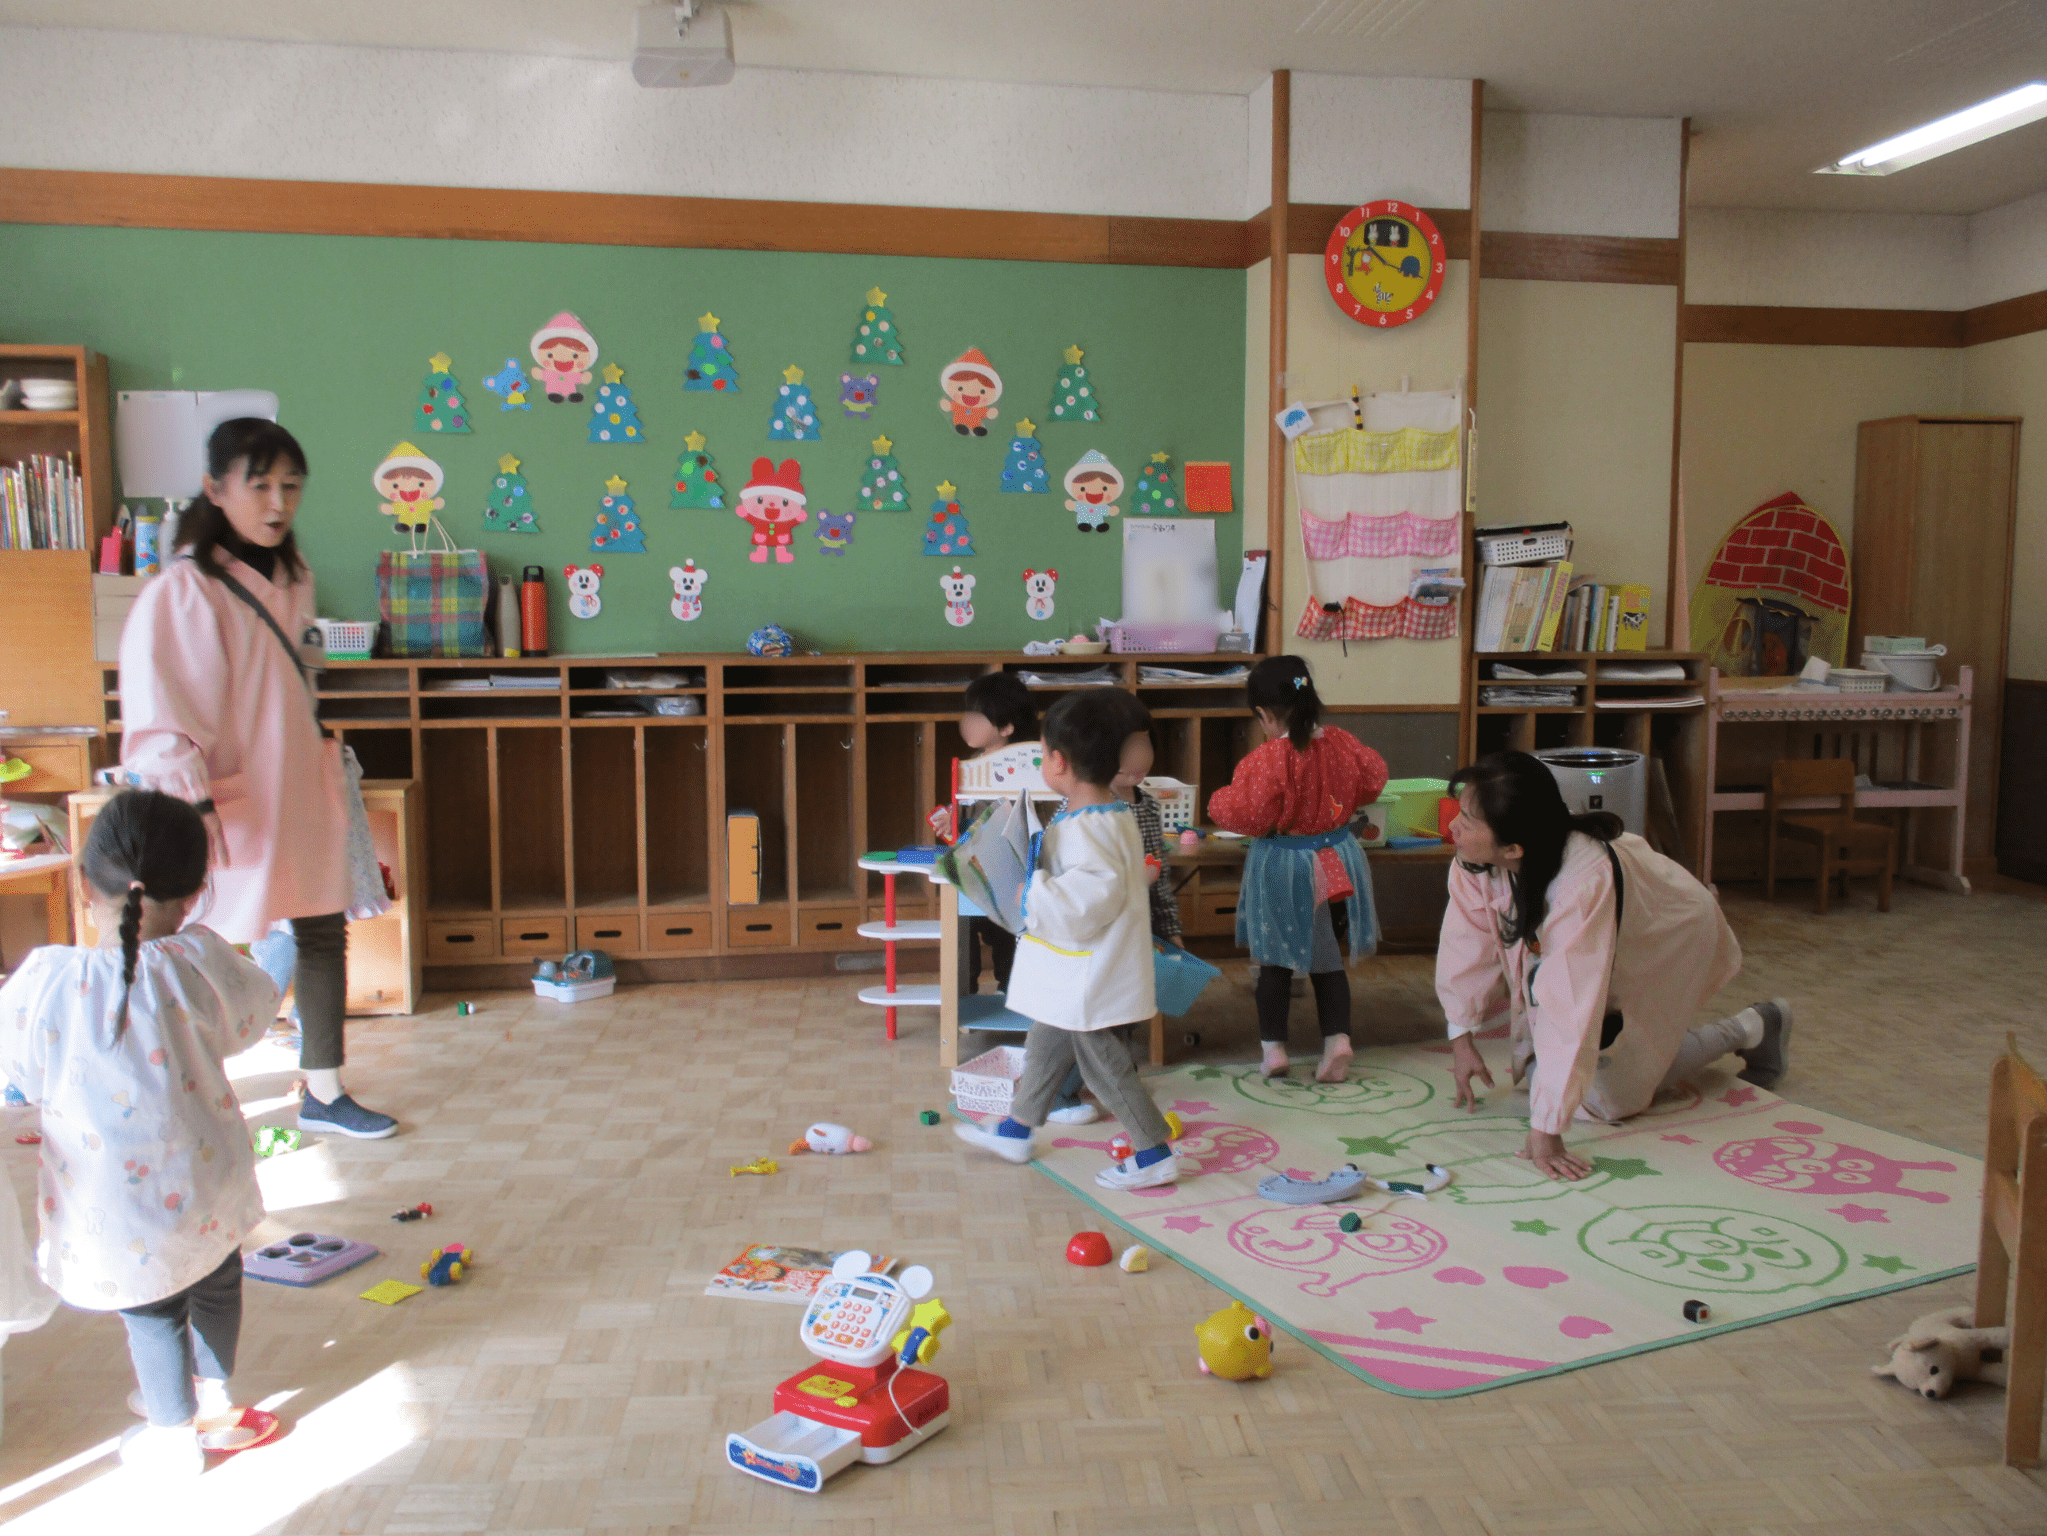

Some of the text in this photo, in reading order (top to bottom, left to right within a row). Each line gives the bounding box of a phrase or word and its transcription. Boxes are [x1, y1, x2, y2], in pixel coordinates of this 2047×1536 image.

[1360, 207, 1370, 218] 11
[1387, 202, 1398, 213] 12
[1415, 212, 1420, 222] 1
[1340, 226, 1350, 237] 10
[1431, 234, 1438, 245] 2
[1331, 254, 1339, 264] 9
[1436, 263, 1443, 273] 3
[1336, 283, 1344, 293] 8
[1426, 290, 1433, 300] 4
[1354, 304, 1361, 315] 7
[1406, 309, 1413, 319] 5
[1379, 314, 1387, 325] 6
